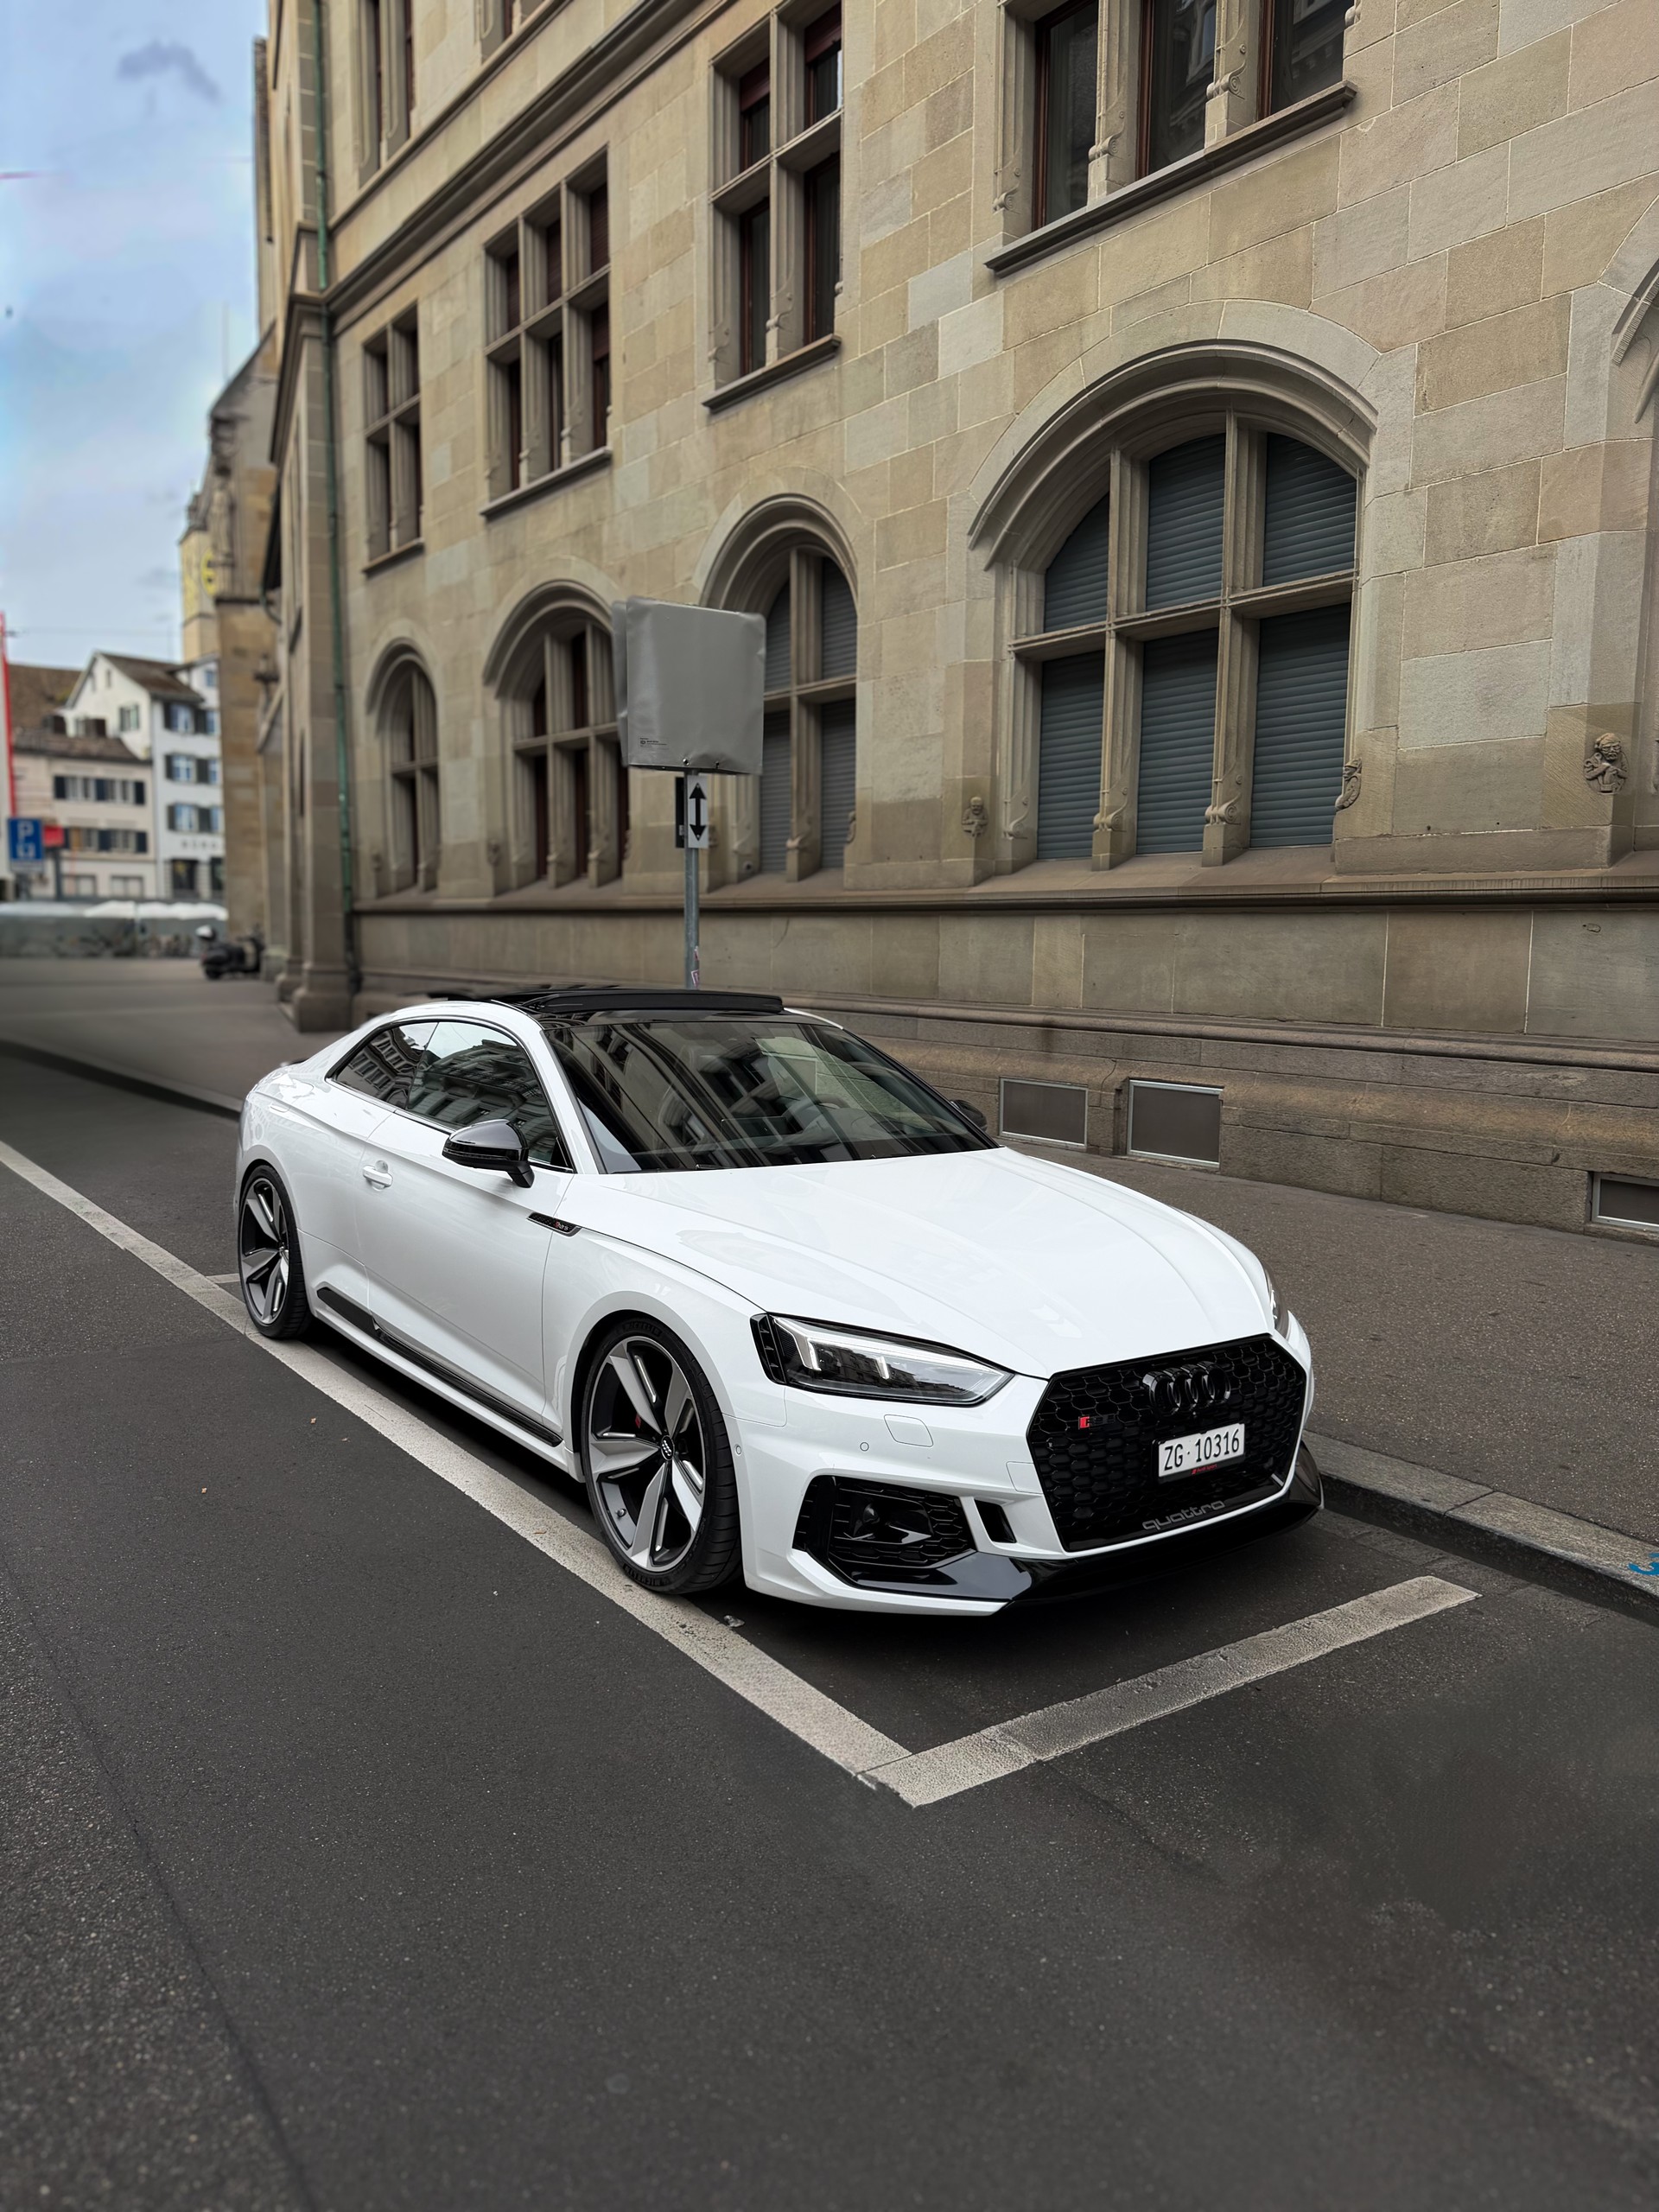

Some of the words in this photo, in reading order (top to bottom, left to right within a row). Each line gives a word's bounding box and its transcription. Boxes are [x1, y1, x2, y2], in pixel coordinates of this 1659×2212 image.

[17, 820, 35, 840] P
[1195, 1428, 1239, 1463] 10316
[1141, 1500, 1225, 1530] quattro
